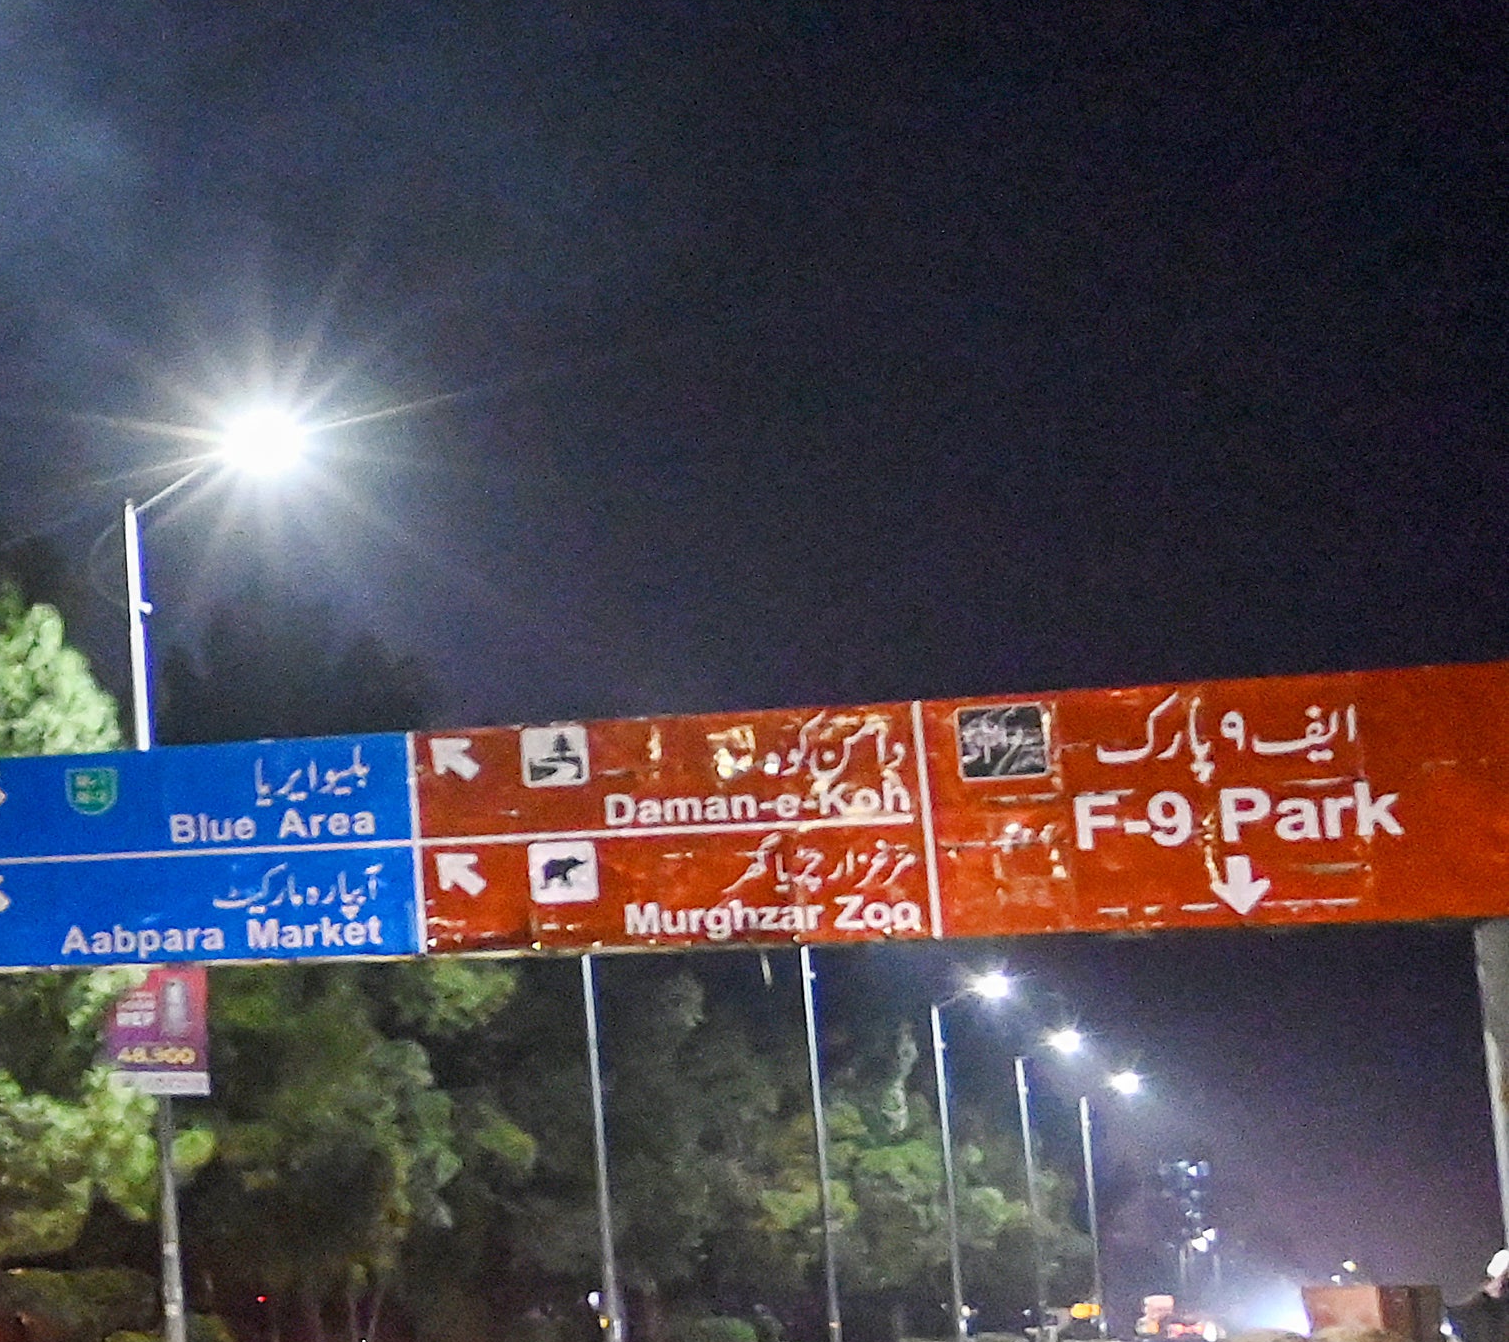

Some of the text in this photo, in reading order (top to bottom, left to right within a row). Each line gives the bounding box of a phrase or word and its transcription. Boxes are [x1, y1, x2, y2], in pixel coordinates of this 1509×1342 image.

[1096, 691, 1216, 785] پارک
[1252, 704, 1357, 762] ایف
[170, 808, 376, 843] Blue Area
[603, 779, 912, 827] Daman-e-Koh
[1074, 779, 1405, 851] F-9 Park
[60, 914, 384, 959] Aabpara Market
[624, 894, 922, 941] Murghzar Zoo
